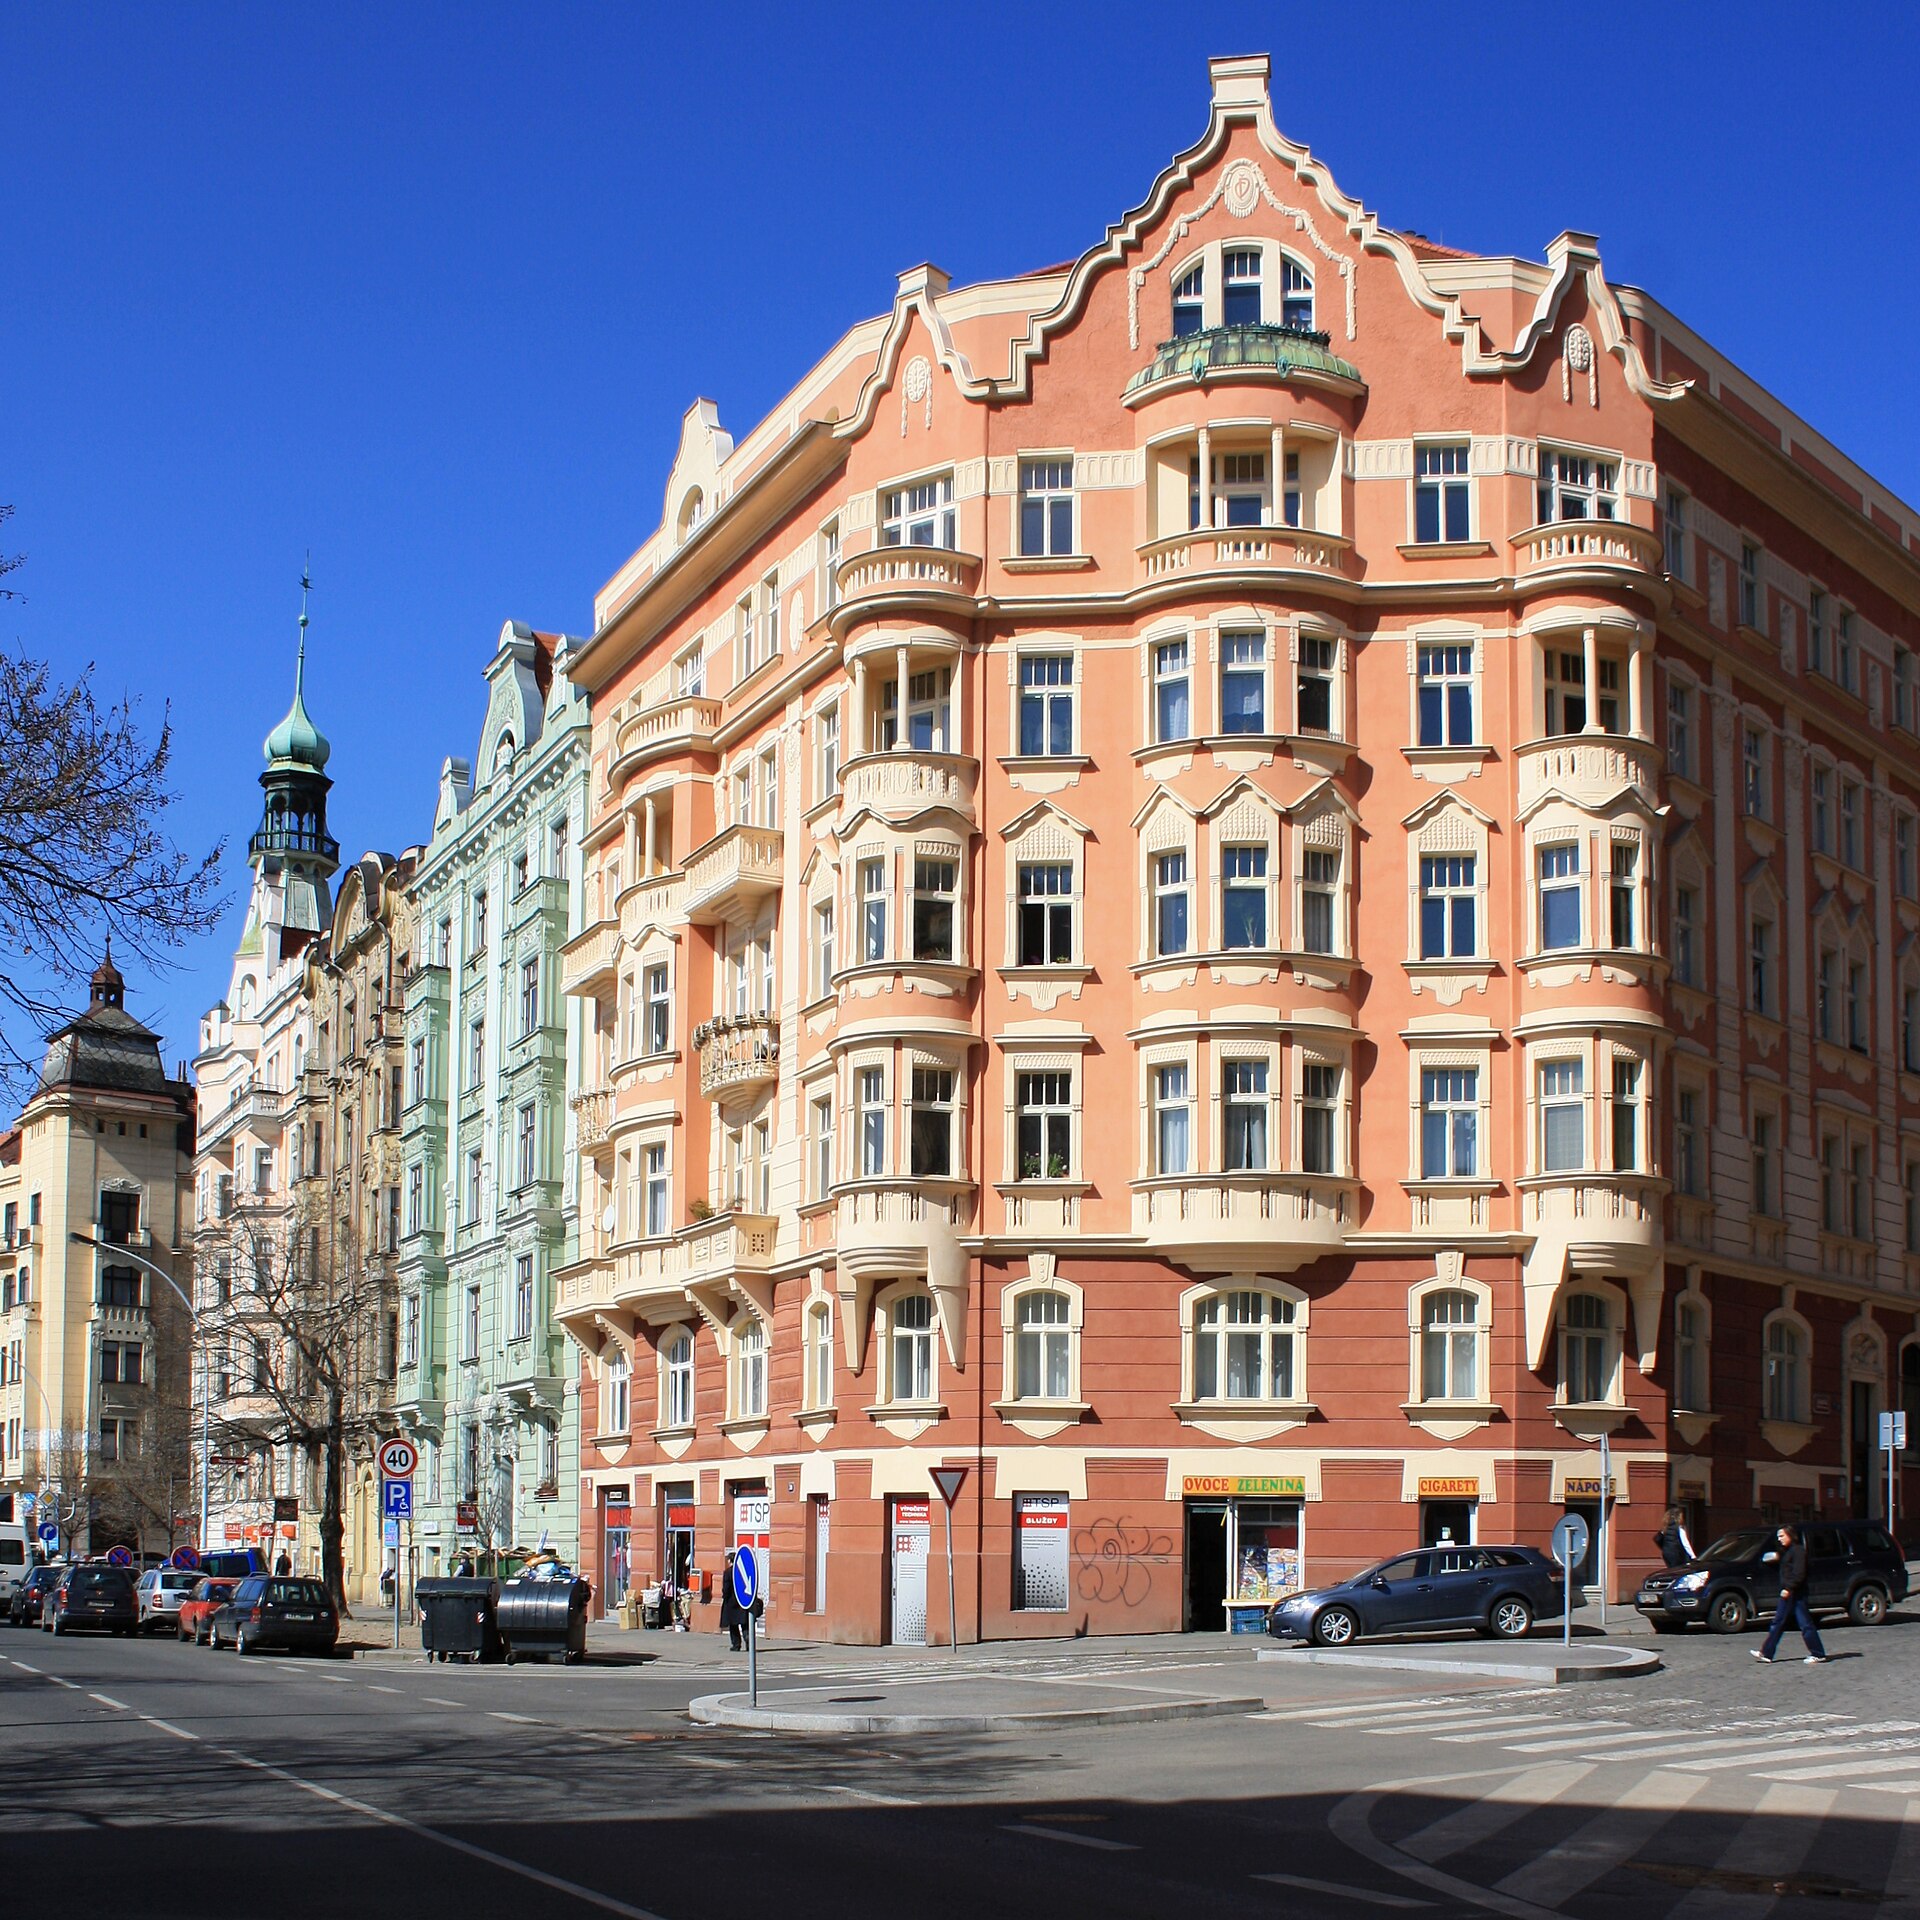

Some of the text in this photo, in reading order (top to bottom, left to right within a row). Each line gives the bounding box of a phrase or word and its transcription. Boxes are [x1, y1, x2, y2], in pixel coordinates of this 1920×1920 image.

[387, 1450, 408, 1467] 40
[1184, 1478, 1304, 1492] OVOCE ZELENINA
[1420, 1480, 1478, 1492] CIGARETY
[389, 1484, 406, 1507] P
[1033, 1498, 1059, 1508] TSP
[748, 1503, 770, 1523] TSP
